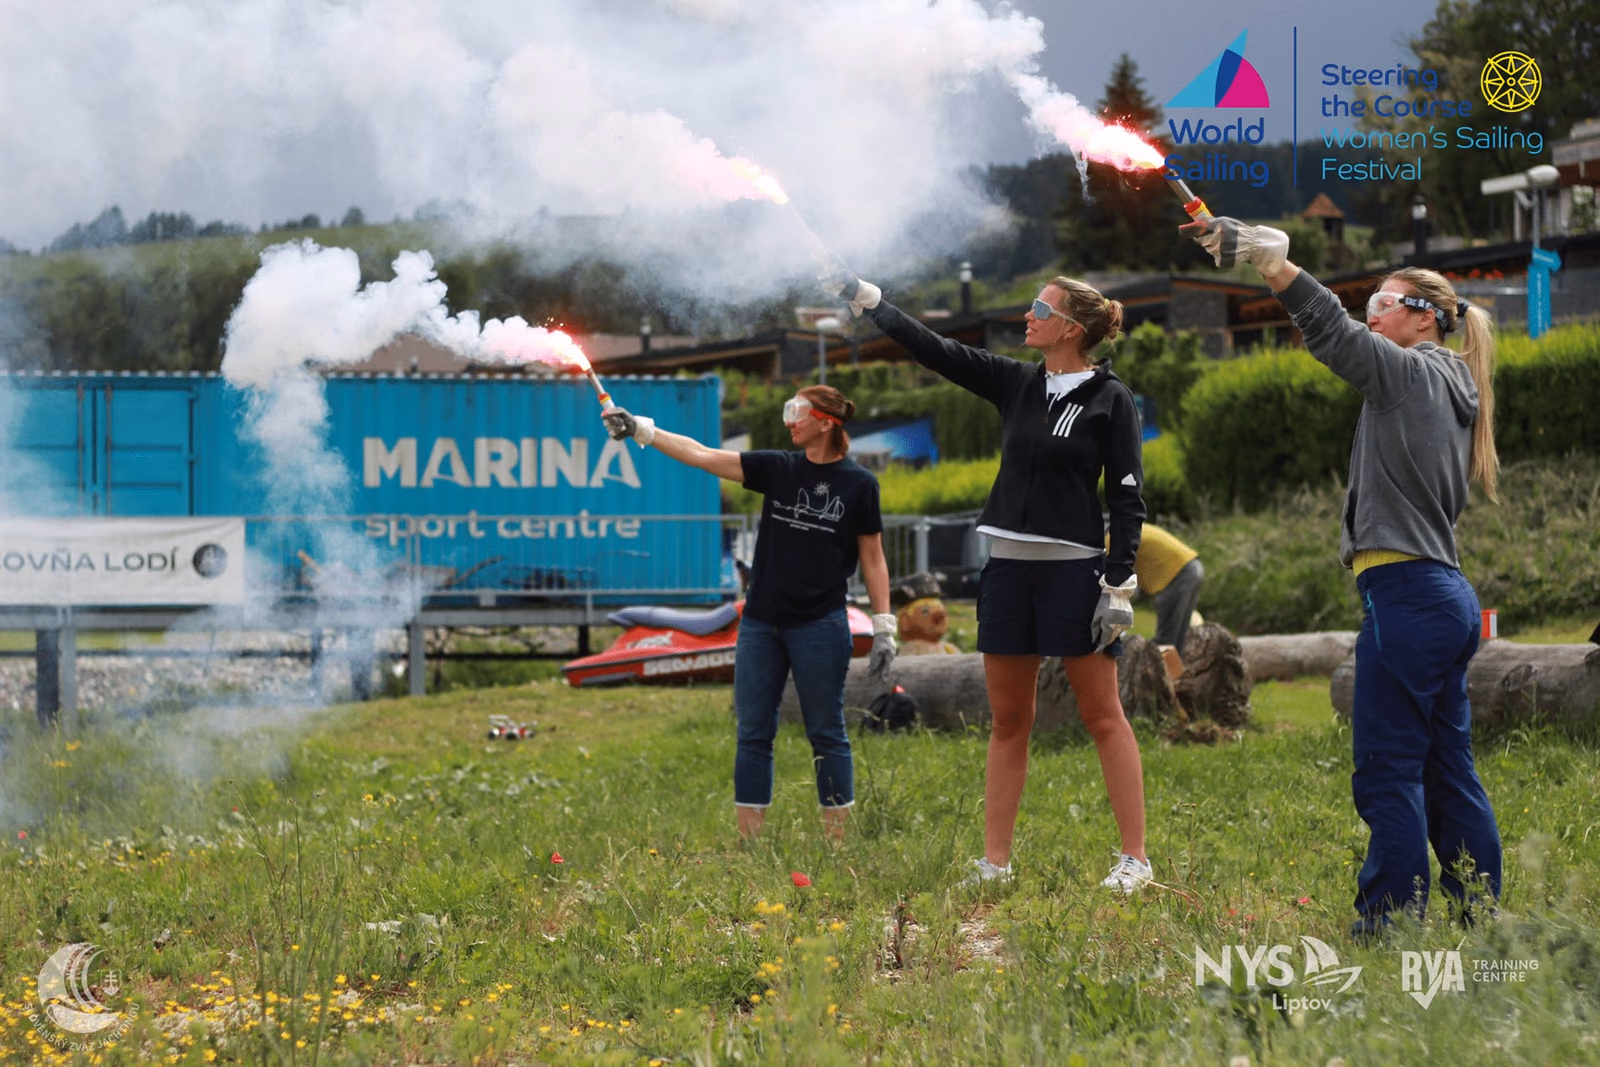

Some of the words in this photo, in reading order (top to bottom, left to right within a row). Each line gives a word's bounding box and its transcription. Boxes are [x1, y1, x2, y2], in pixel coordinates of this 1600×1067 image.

[363, 436, 642, 488] MARINA
[365, 509, 486, 547] sport
[497, 509, 641, 539] centre
[0, 547, 96, 572] OVŇA
[104, 546, 179, 572] LODÍ
